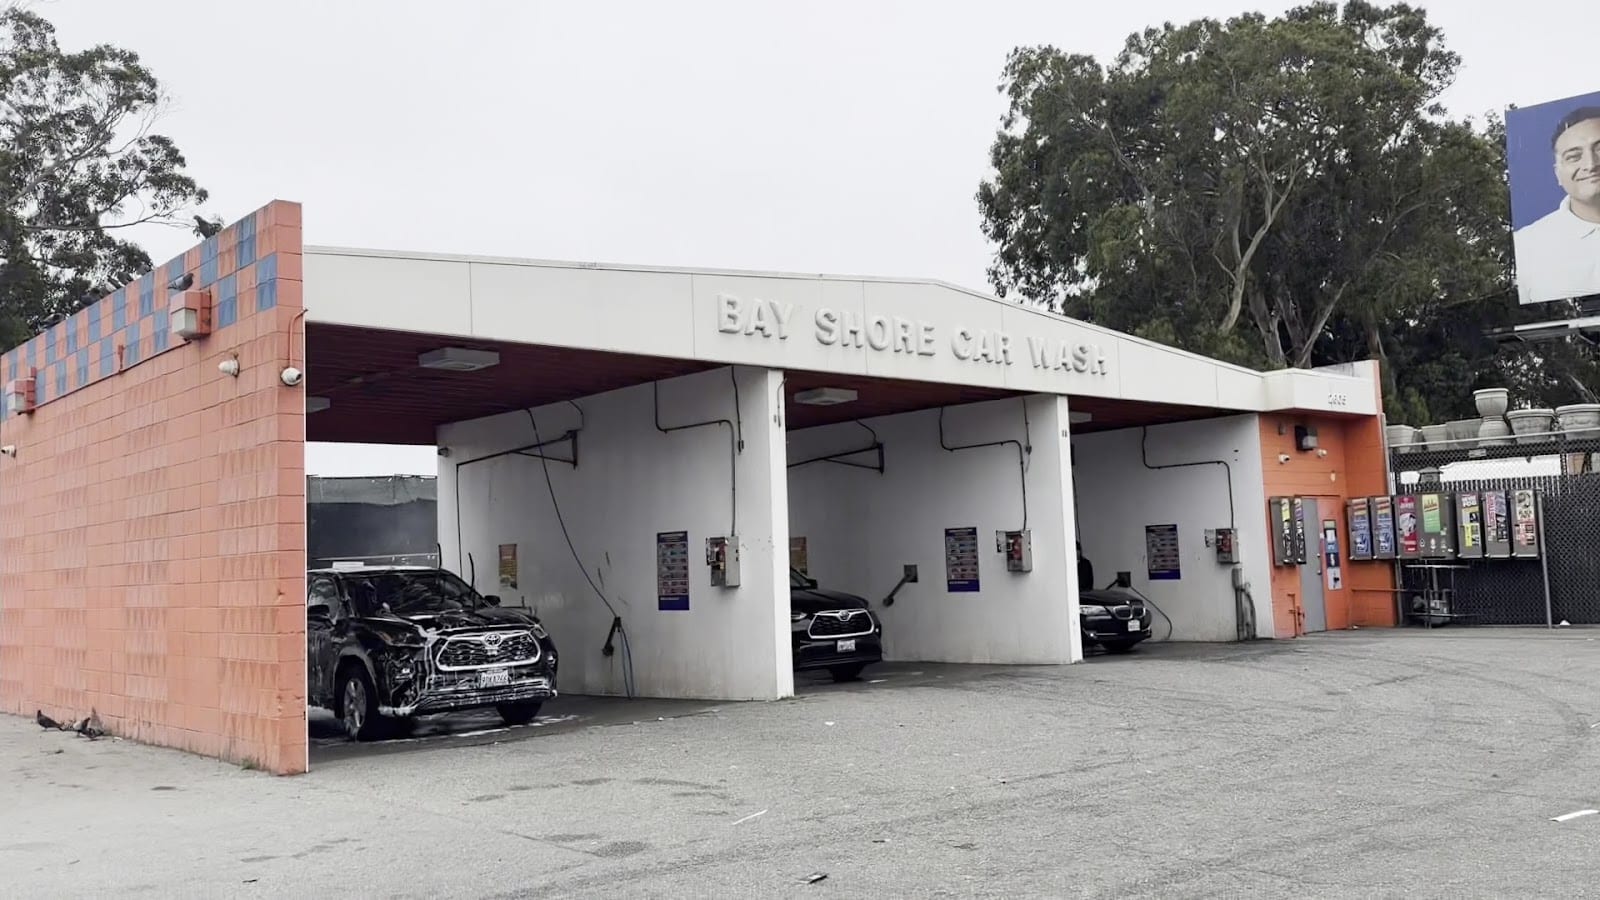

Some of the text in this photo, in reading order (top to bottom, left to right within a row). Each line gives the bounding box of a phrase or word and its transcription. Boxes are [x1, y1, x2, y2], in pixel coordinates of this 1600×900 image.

[717, 294, 1108, 376] BAY SHORE CAR WASH
